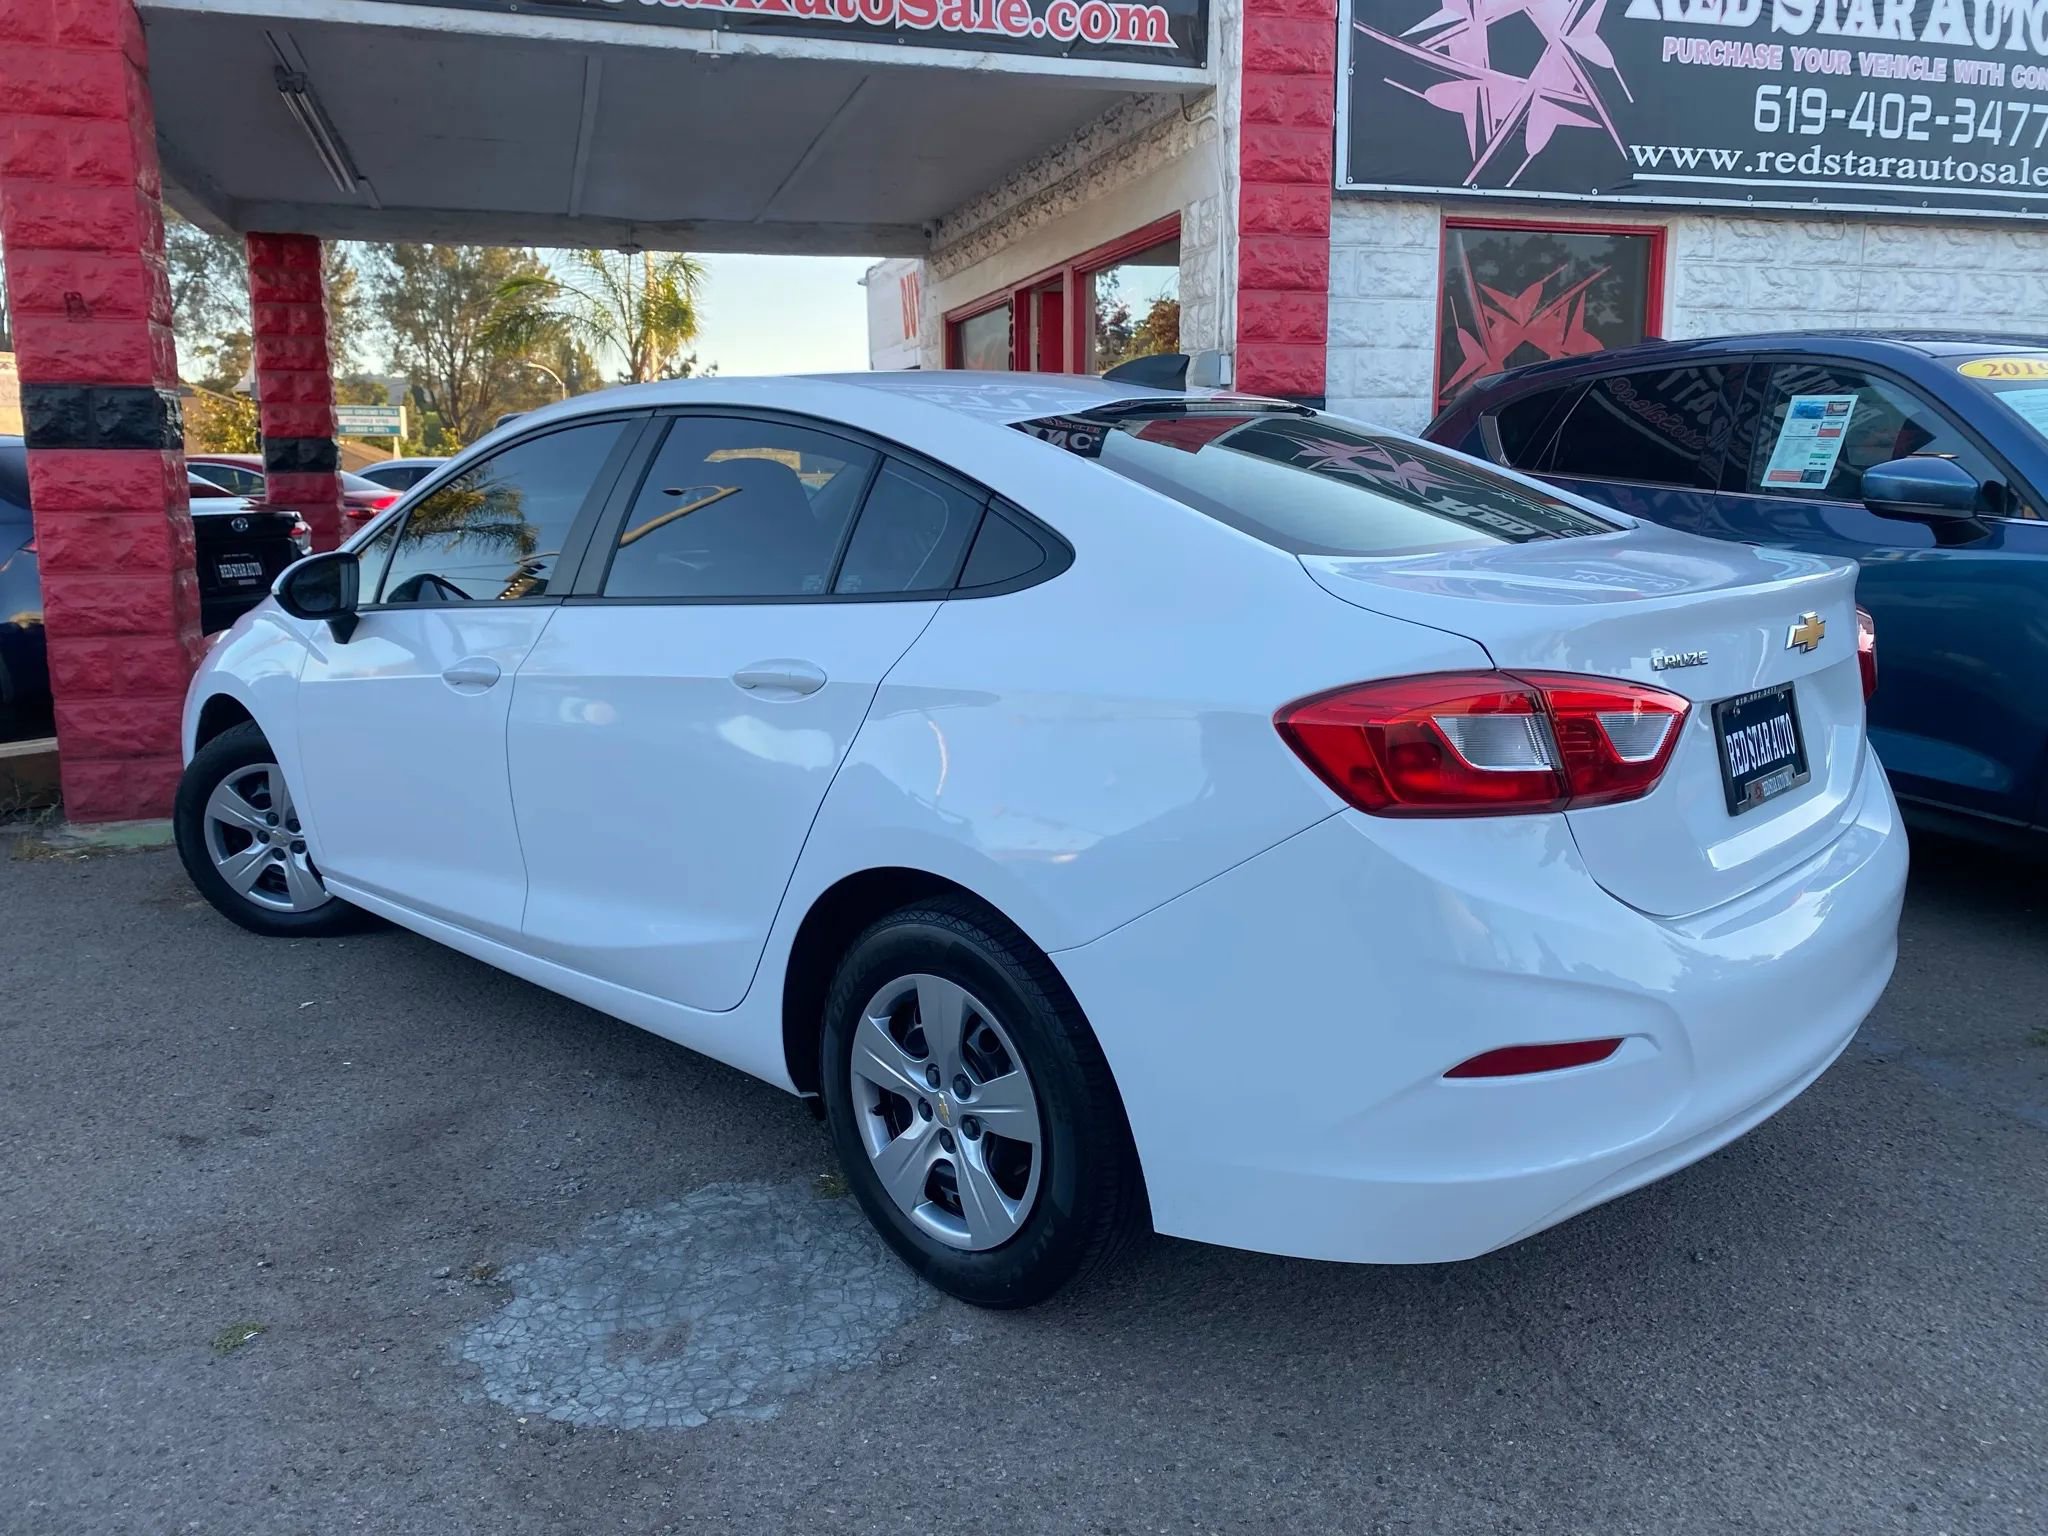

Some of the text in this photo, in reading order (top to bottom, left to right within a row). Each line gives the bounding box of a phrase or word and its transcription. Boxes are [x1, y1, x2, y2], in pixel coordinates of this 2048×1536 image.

[1771, 0, 1915, 41] STAR
[1662, 36, 1783, 70] PURCHASE
[1790, 46, 1851, 75] YOUR
[1858, 52, 1947, 82] VEHICLE
[1953, 59, 2005, 87] WITH
[1754, 84, 2048, 149] 619-402-3477
[1651, 651, 1708, 670] CRUZE
[1726, 712, 1795, 778] RED STAR AUTO
